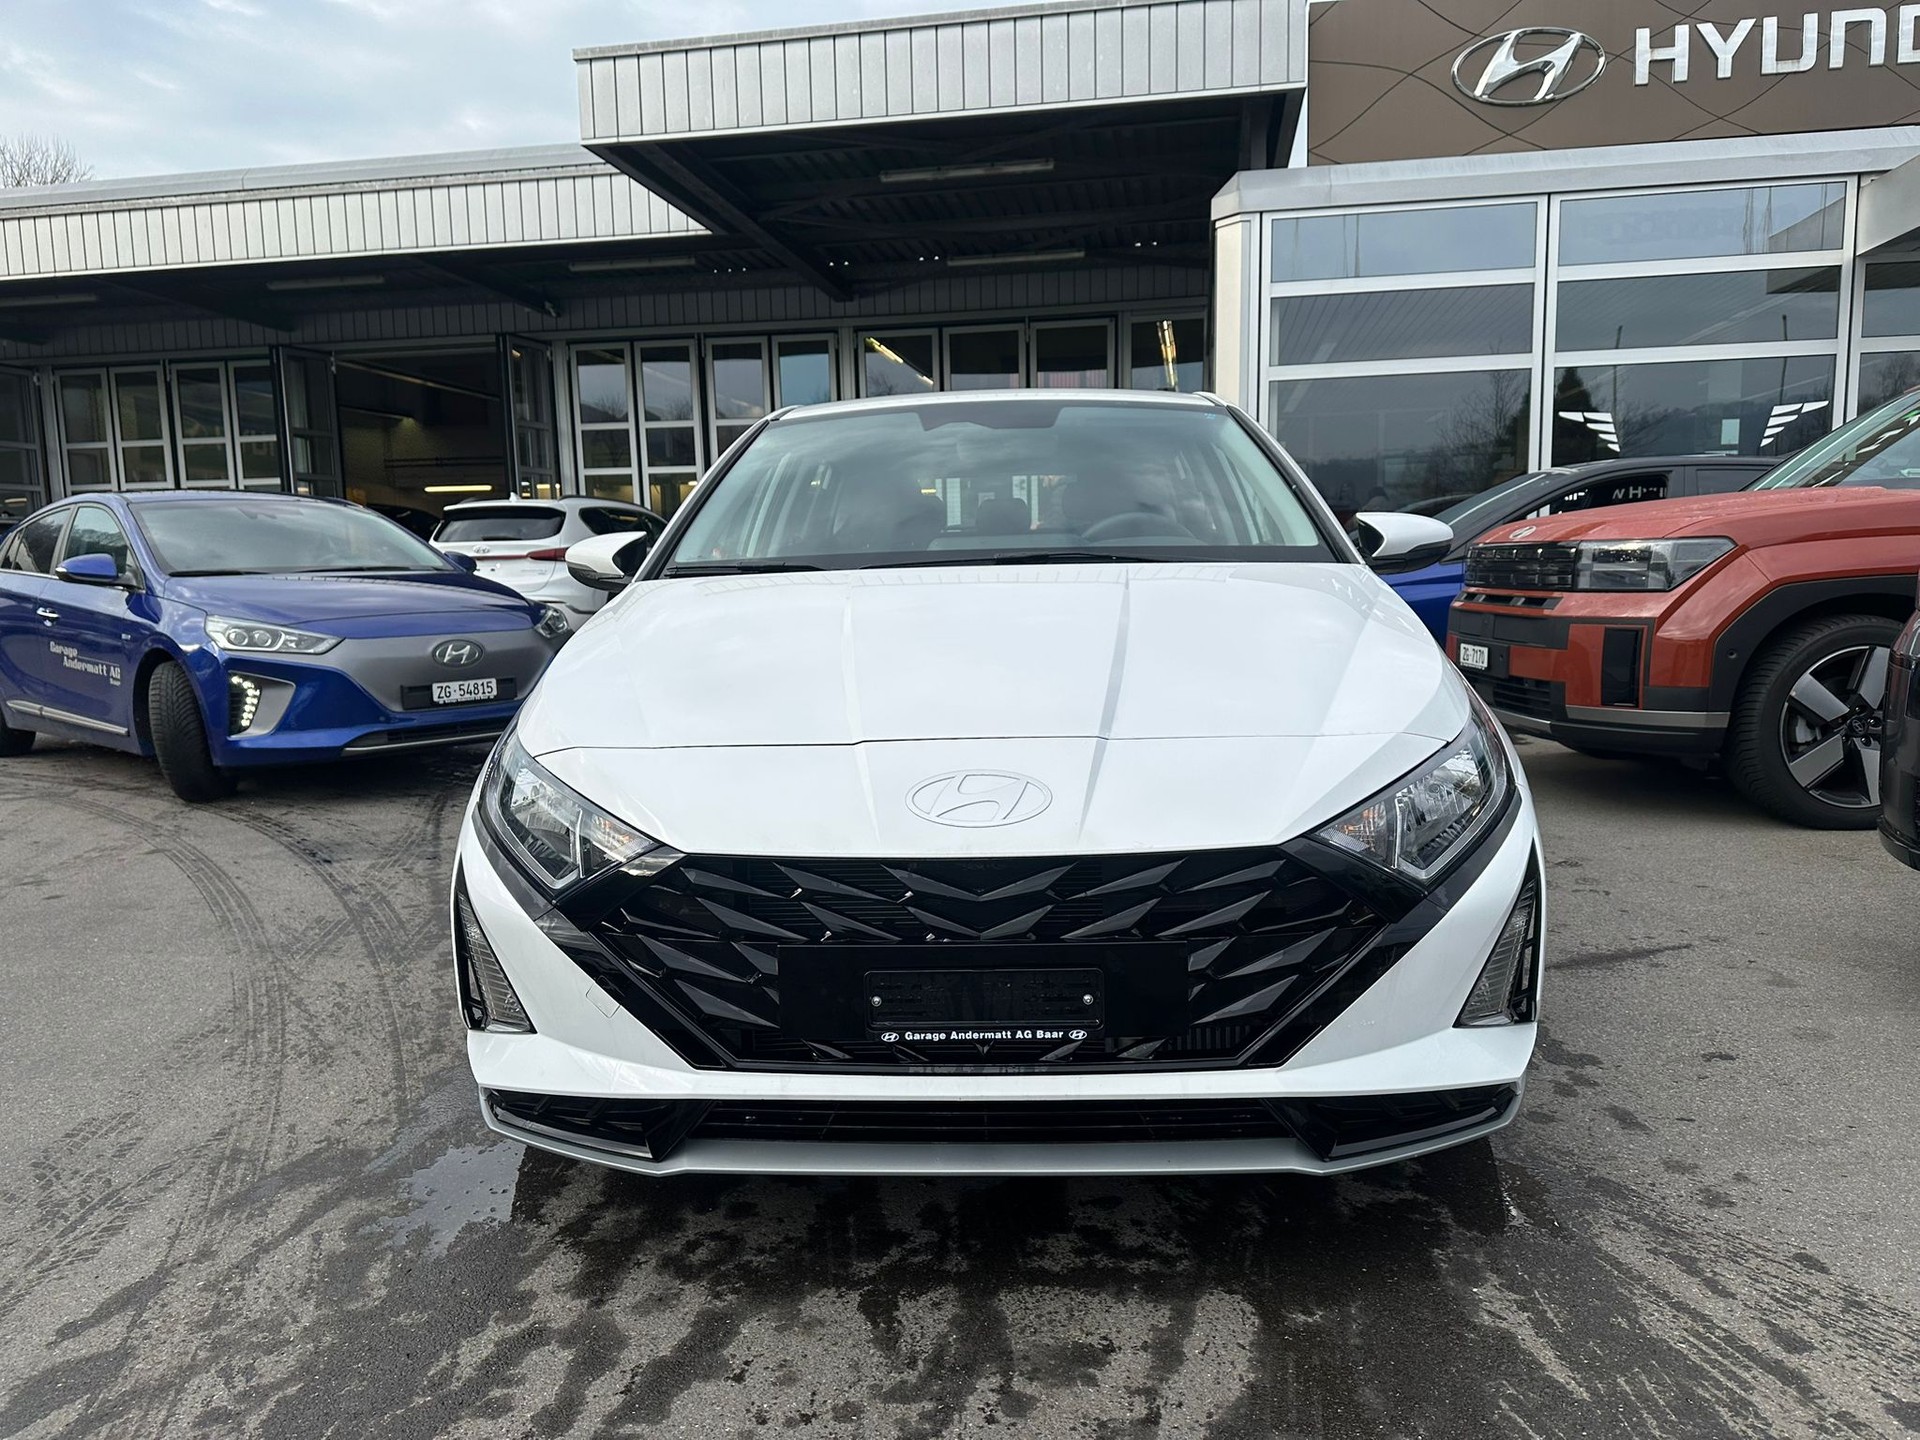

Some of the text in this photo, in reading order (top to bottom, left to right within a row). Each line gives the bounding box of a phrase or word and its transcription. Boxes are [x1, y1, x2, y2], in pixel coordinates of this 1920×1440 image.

[49, 641, 78, 658] Garage
[63, 656, 121, 680] Andermatt AG
[904, 1029, 1064, 1042] Garage Andermatt AG Baar
